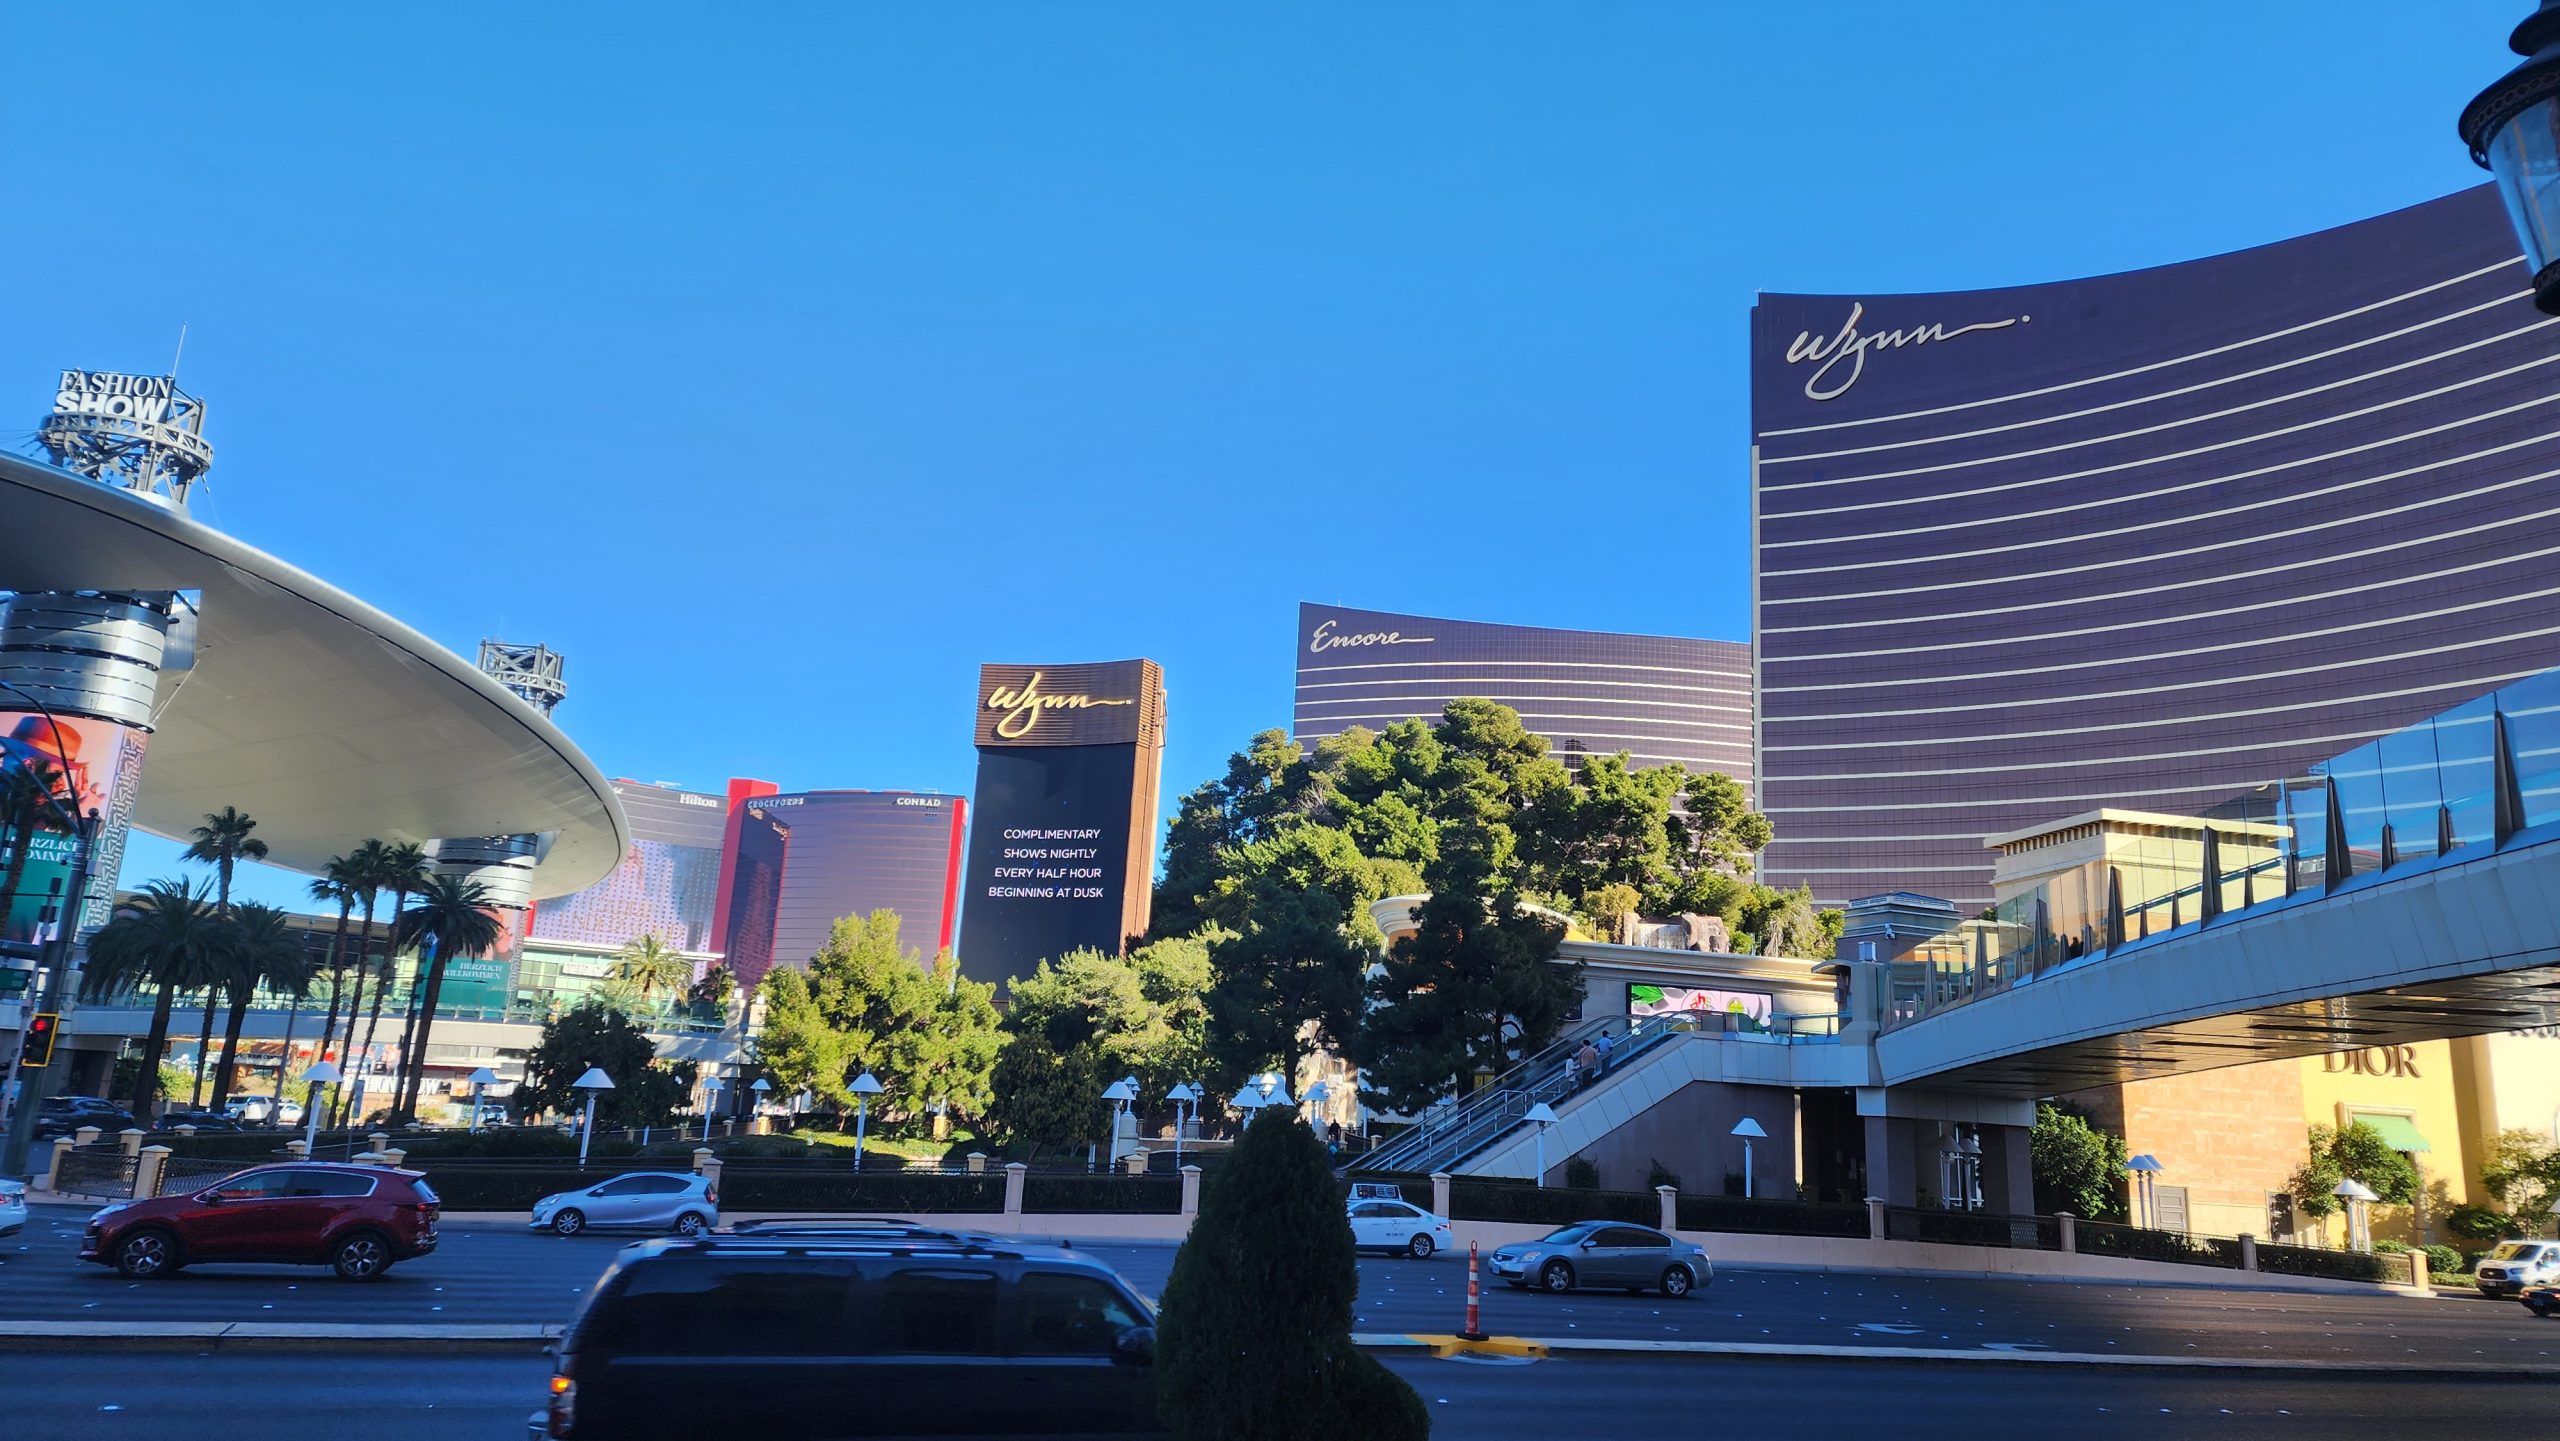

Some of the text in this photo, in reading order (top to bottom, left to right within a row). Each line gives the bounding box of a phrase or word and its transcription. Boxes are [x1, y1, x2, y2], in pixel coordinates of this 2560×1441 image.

[57, 370, 173, 398] FASHION
[53, 391, 169, 424] SHOW
[1310, 619, 1435, 653] Encore
[680, 793, 718, 808] Hilton
[747, 797, 804, 809] CROCKFORDS
[896, 797, 941, 807] CONRAD
[1003, 829, 1101, 840] COMPLIMENTARY
[1003, 848, 1097, 859] SHOWS NIGHTLY
[994, 867, 1102, 879] EVERY HALF HOUR
[988, 886, 1104, 898] BEGINNING AT DUSK
[460, 962, 502, 972] HERZLICH
[2321, 1043, 2422, 1079] DIOR
